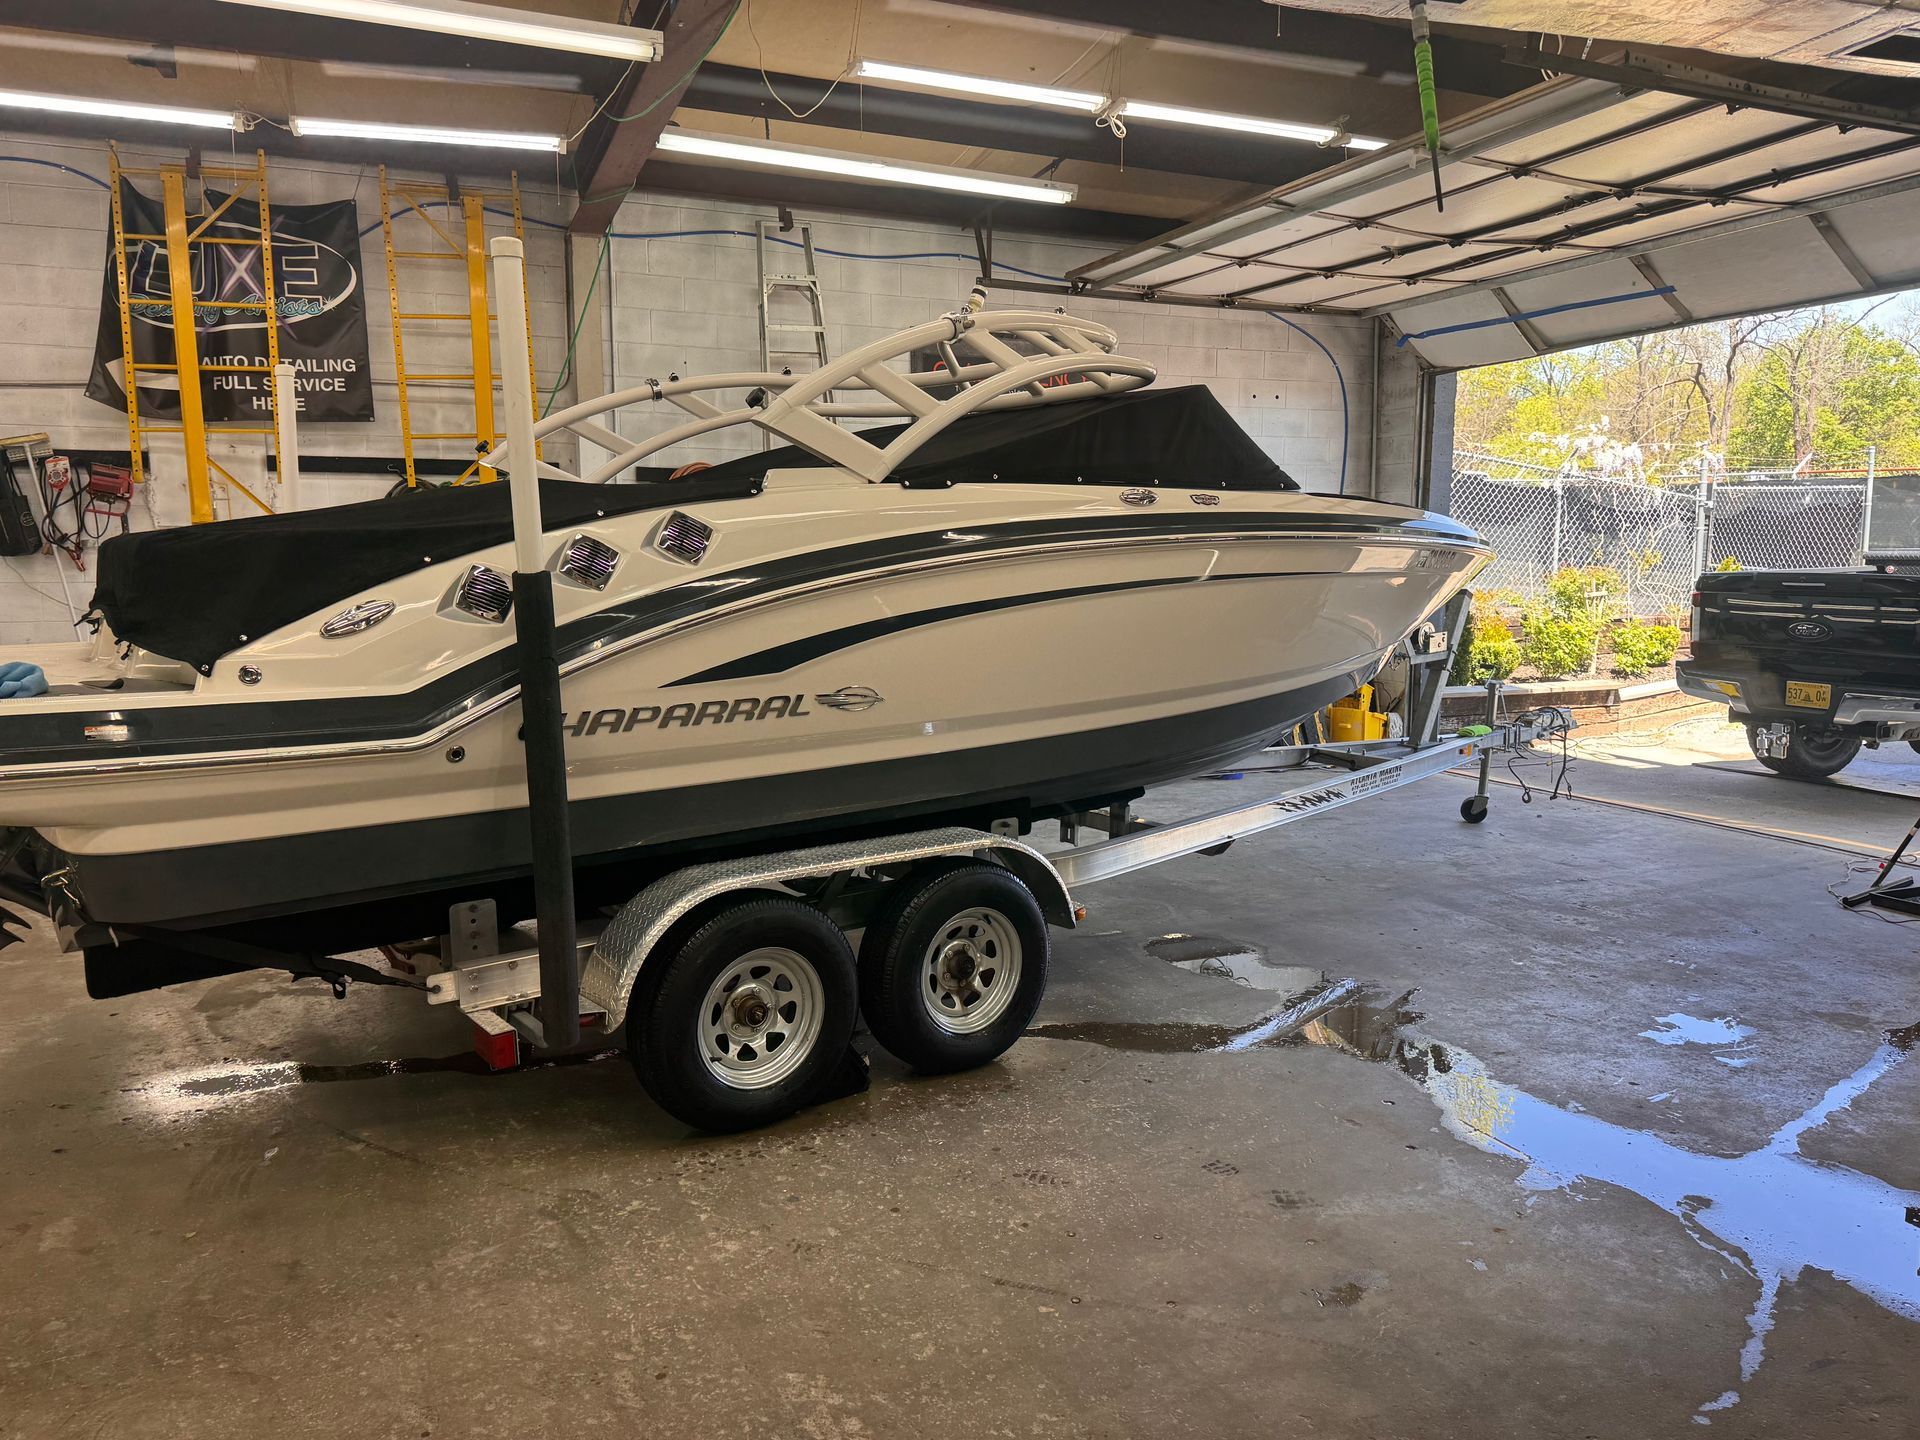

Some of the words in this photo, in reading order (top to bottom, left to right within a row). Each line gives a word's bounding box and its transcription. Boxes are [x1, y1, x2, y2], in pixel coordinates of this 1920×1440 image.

[202, 355, 249, 369] AUTO
[254, 356, 357, 373] DTAILING
[213, 375, 258, 391] FULL
[263, 377, 346, 392] SRVICE
[252, 396, 306, 412] HEE
[1788, 687, 1803, 700] 537
[518, 693, 810, 741] HAPARRAL
[1379, 765, 1403, 778] MARINE
